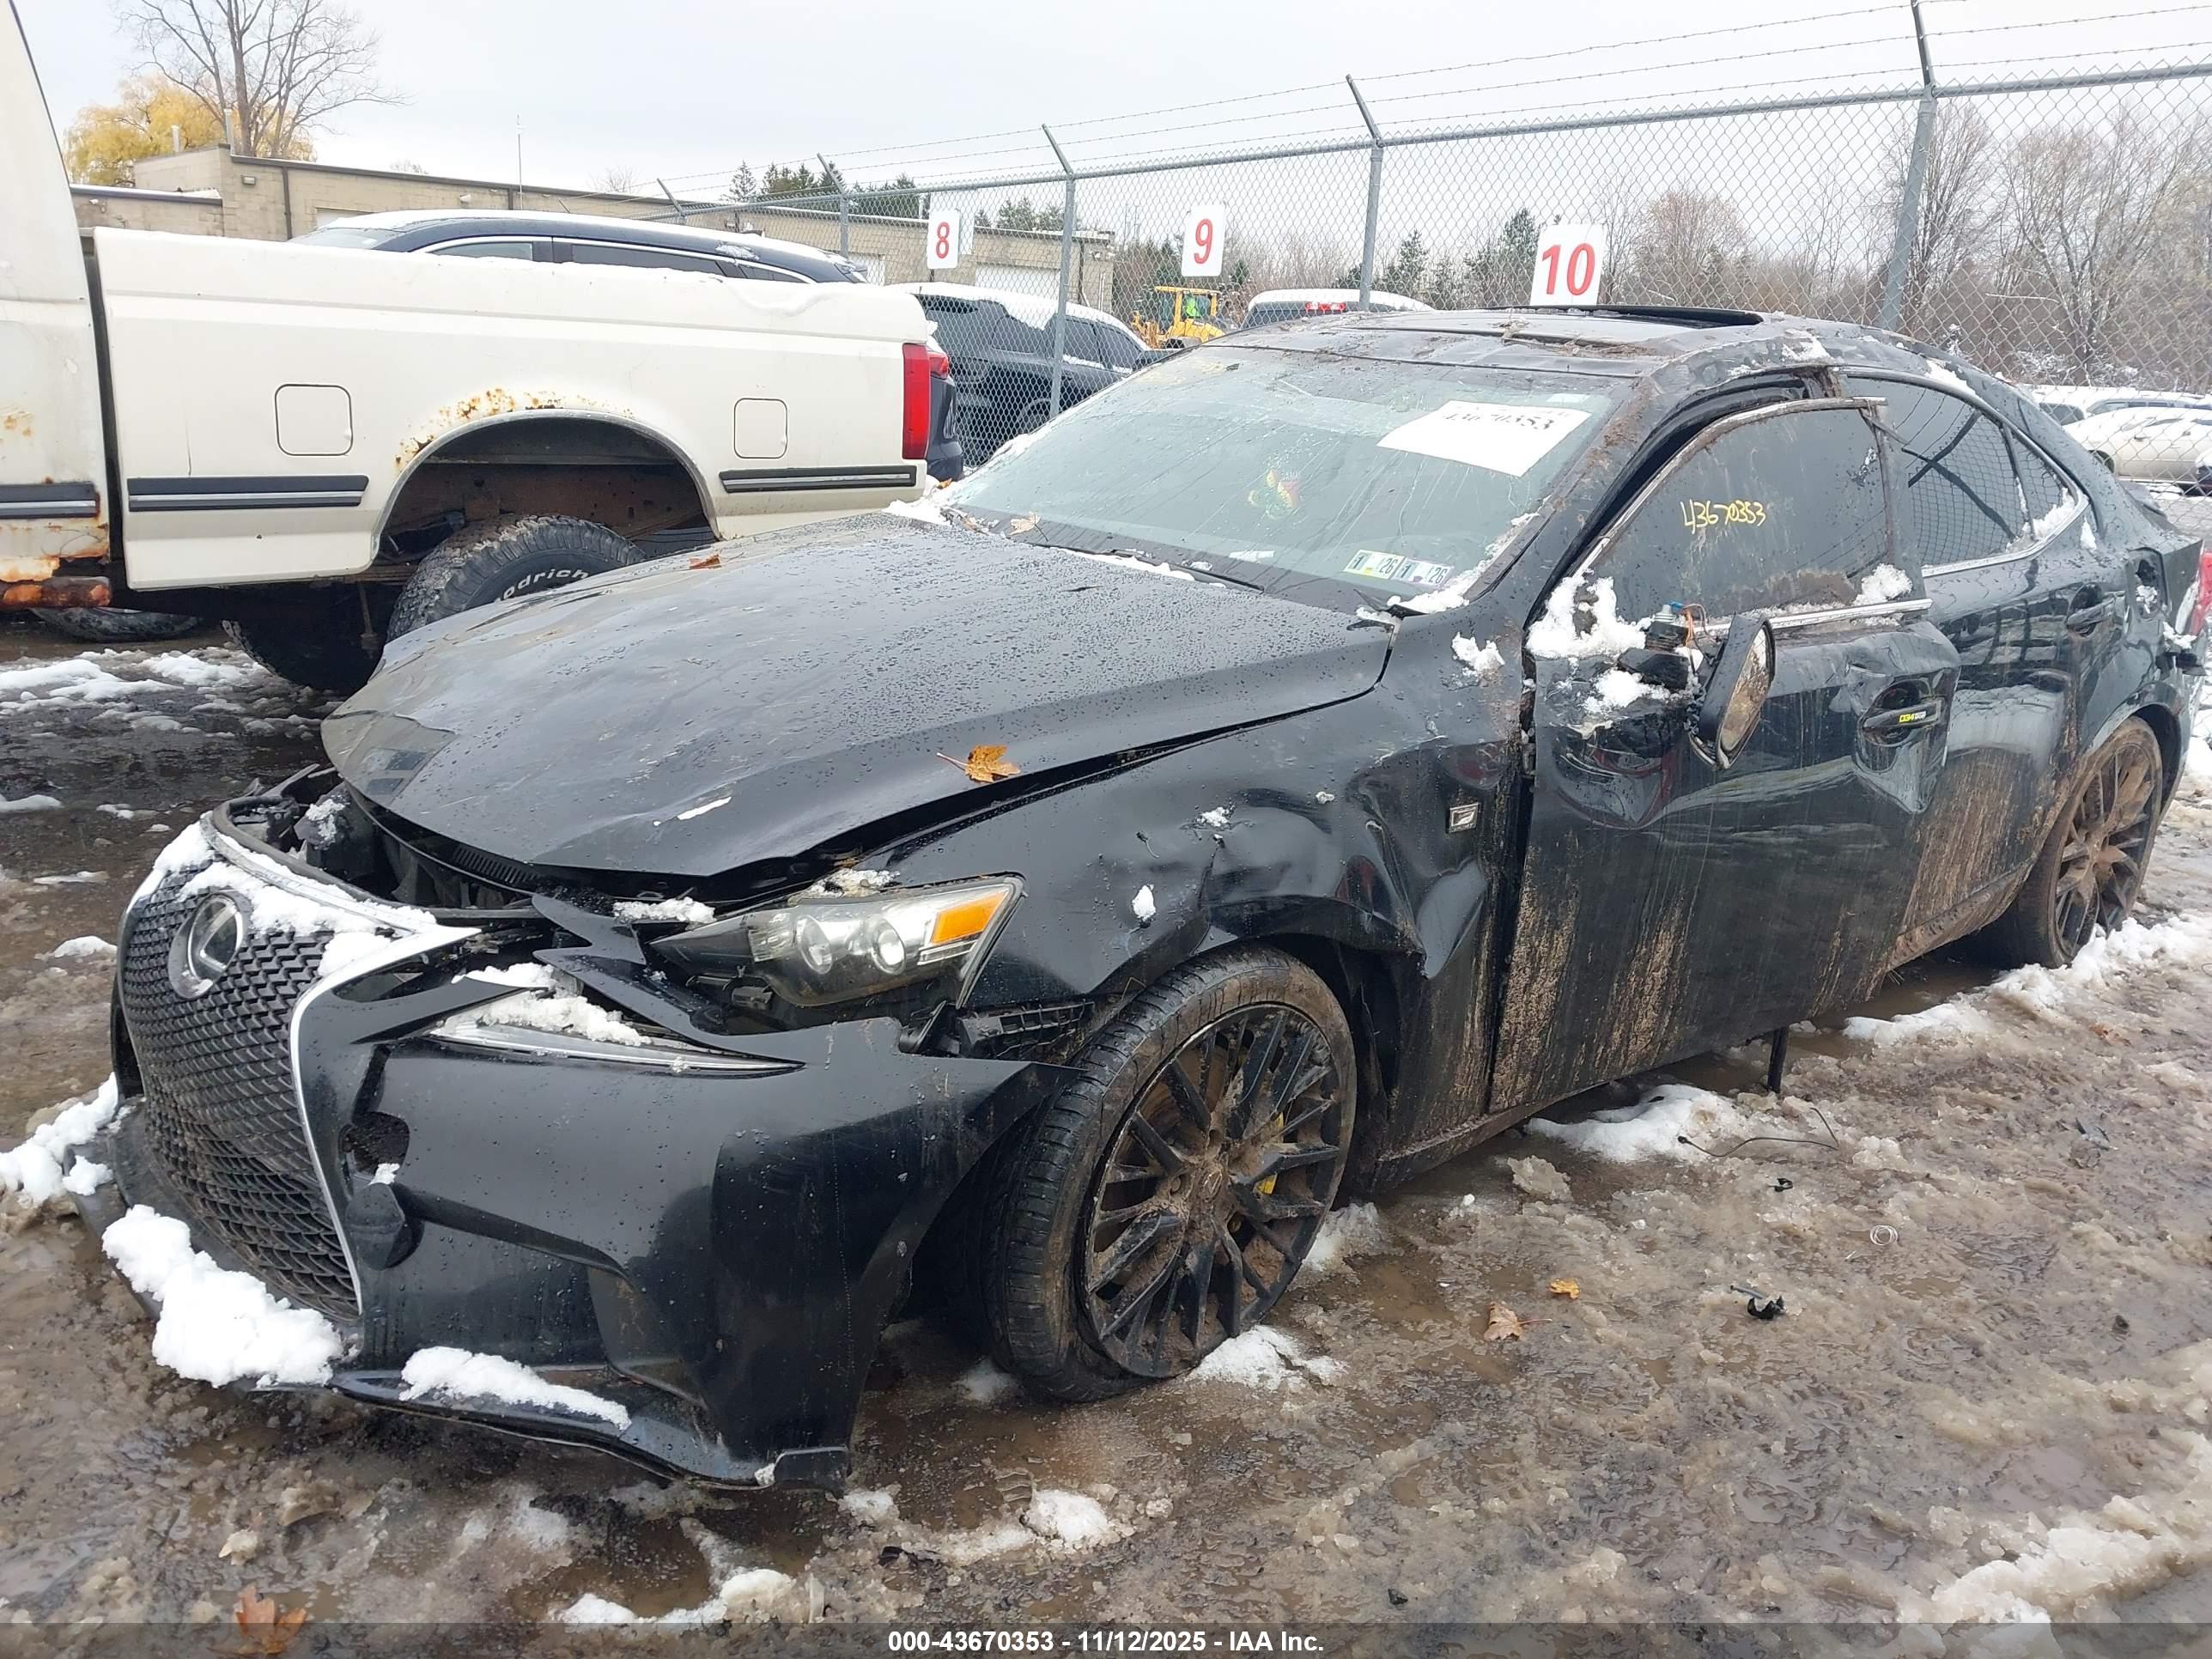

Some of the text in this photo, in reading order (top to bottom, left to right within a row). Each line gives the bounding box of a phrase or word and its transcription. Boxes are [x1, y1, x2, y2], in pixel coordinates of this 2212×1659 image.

[936, 222, 950, 259] 8
[1194, 218, 1213, 264] 9
[1542, 243, 1595, 296] 10
[1680, 499, 1766, 534] 43670353
[495, 568, 589, 602] odrich
[1428, 567, 1448, 584] 26
